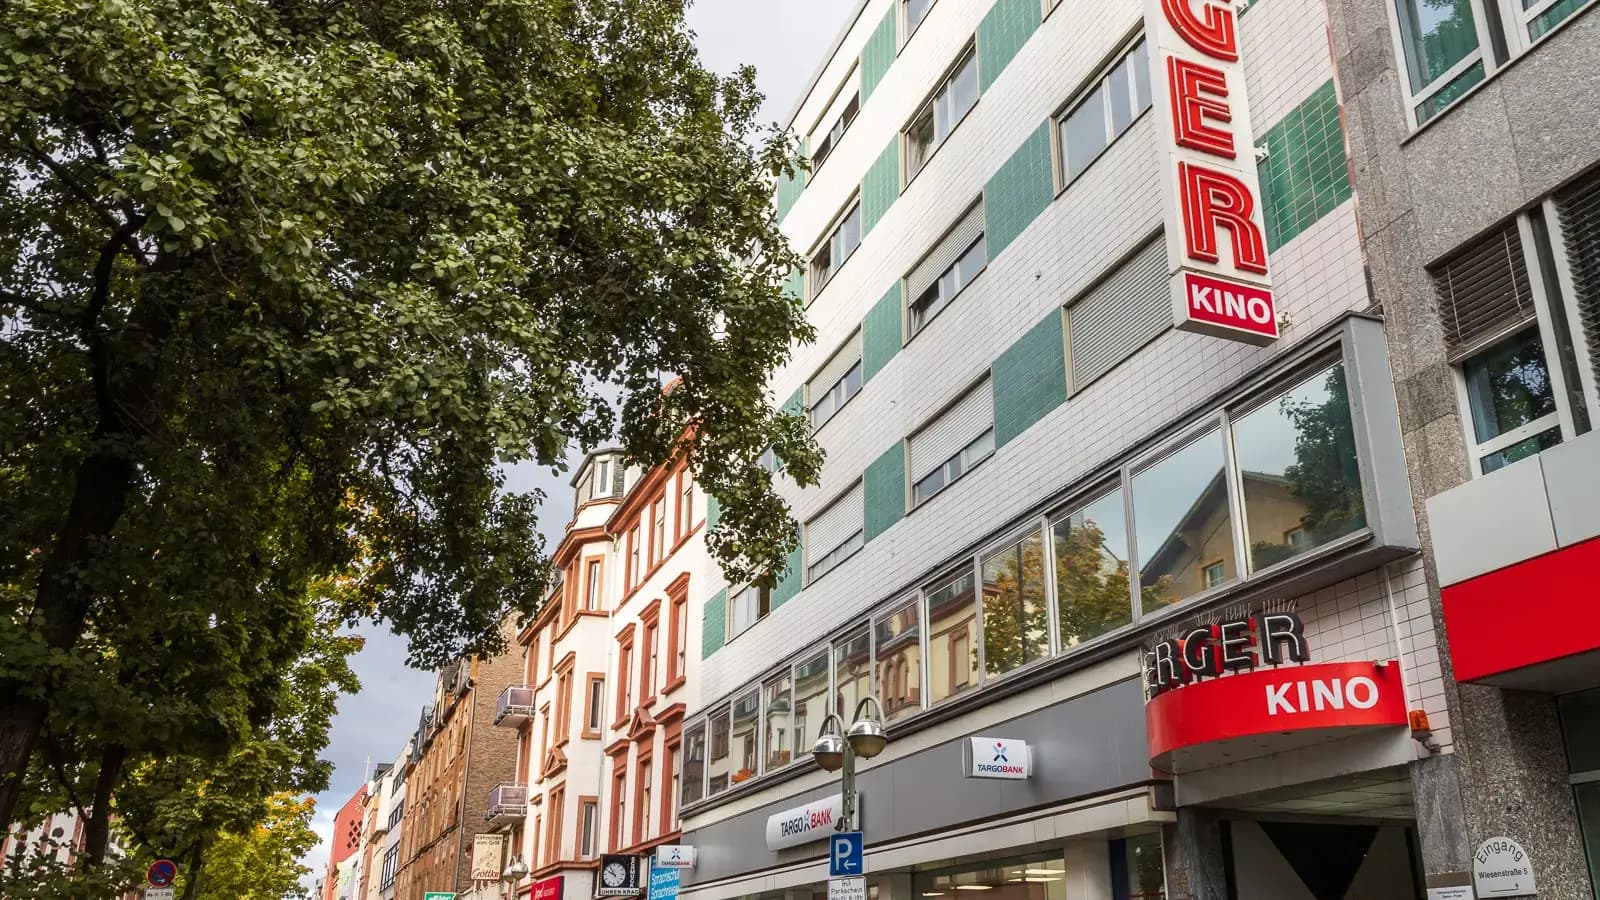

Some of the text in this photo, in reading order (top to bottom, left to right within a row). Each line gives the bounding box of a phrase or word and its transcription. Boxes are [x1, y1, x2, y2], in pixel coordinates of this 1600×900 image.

[1191, 283, 1271, 324] KINO
[1265, 676, 1379, 716] KINO
[977, 764, 1024, 774] TARGOBANK
[835, 839, 852, 870] P
[1476, 841, 1523, 864] Eingang
[1478, 868, 1522, 879] Wiesenstraße
